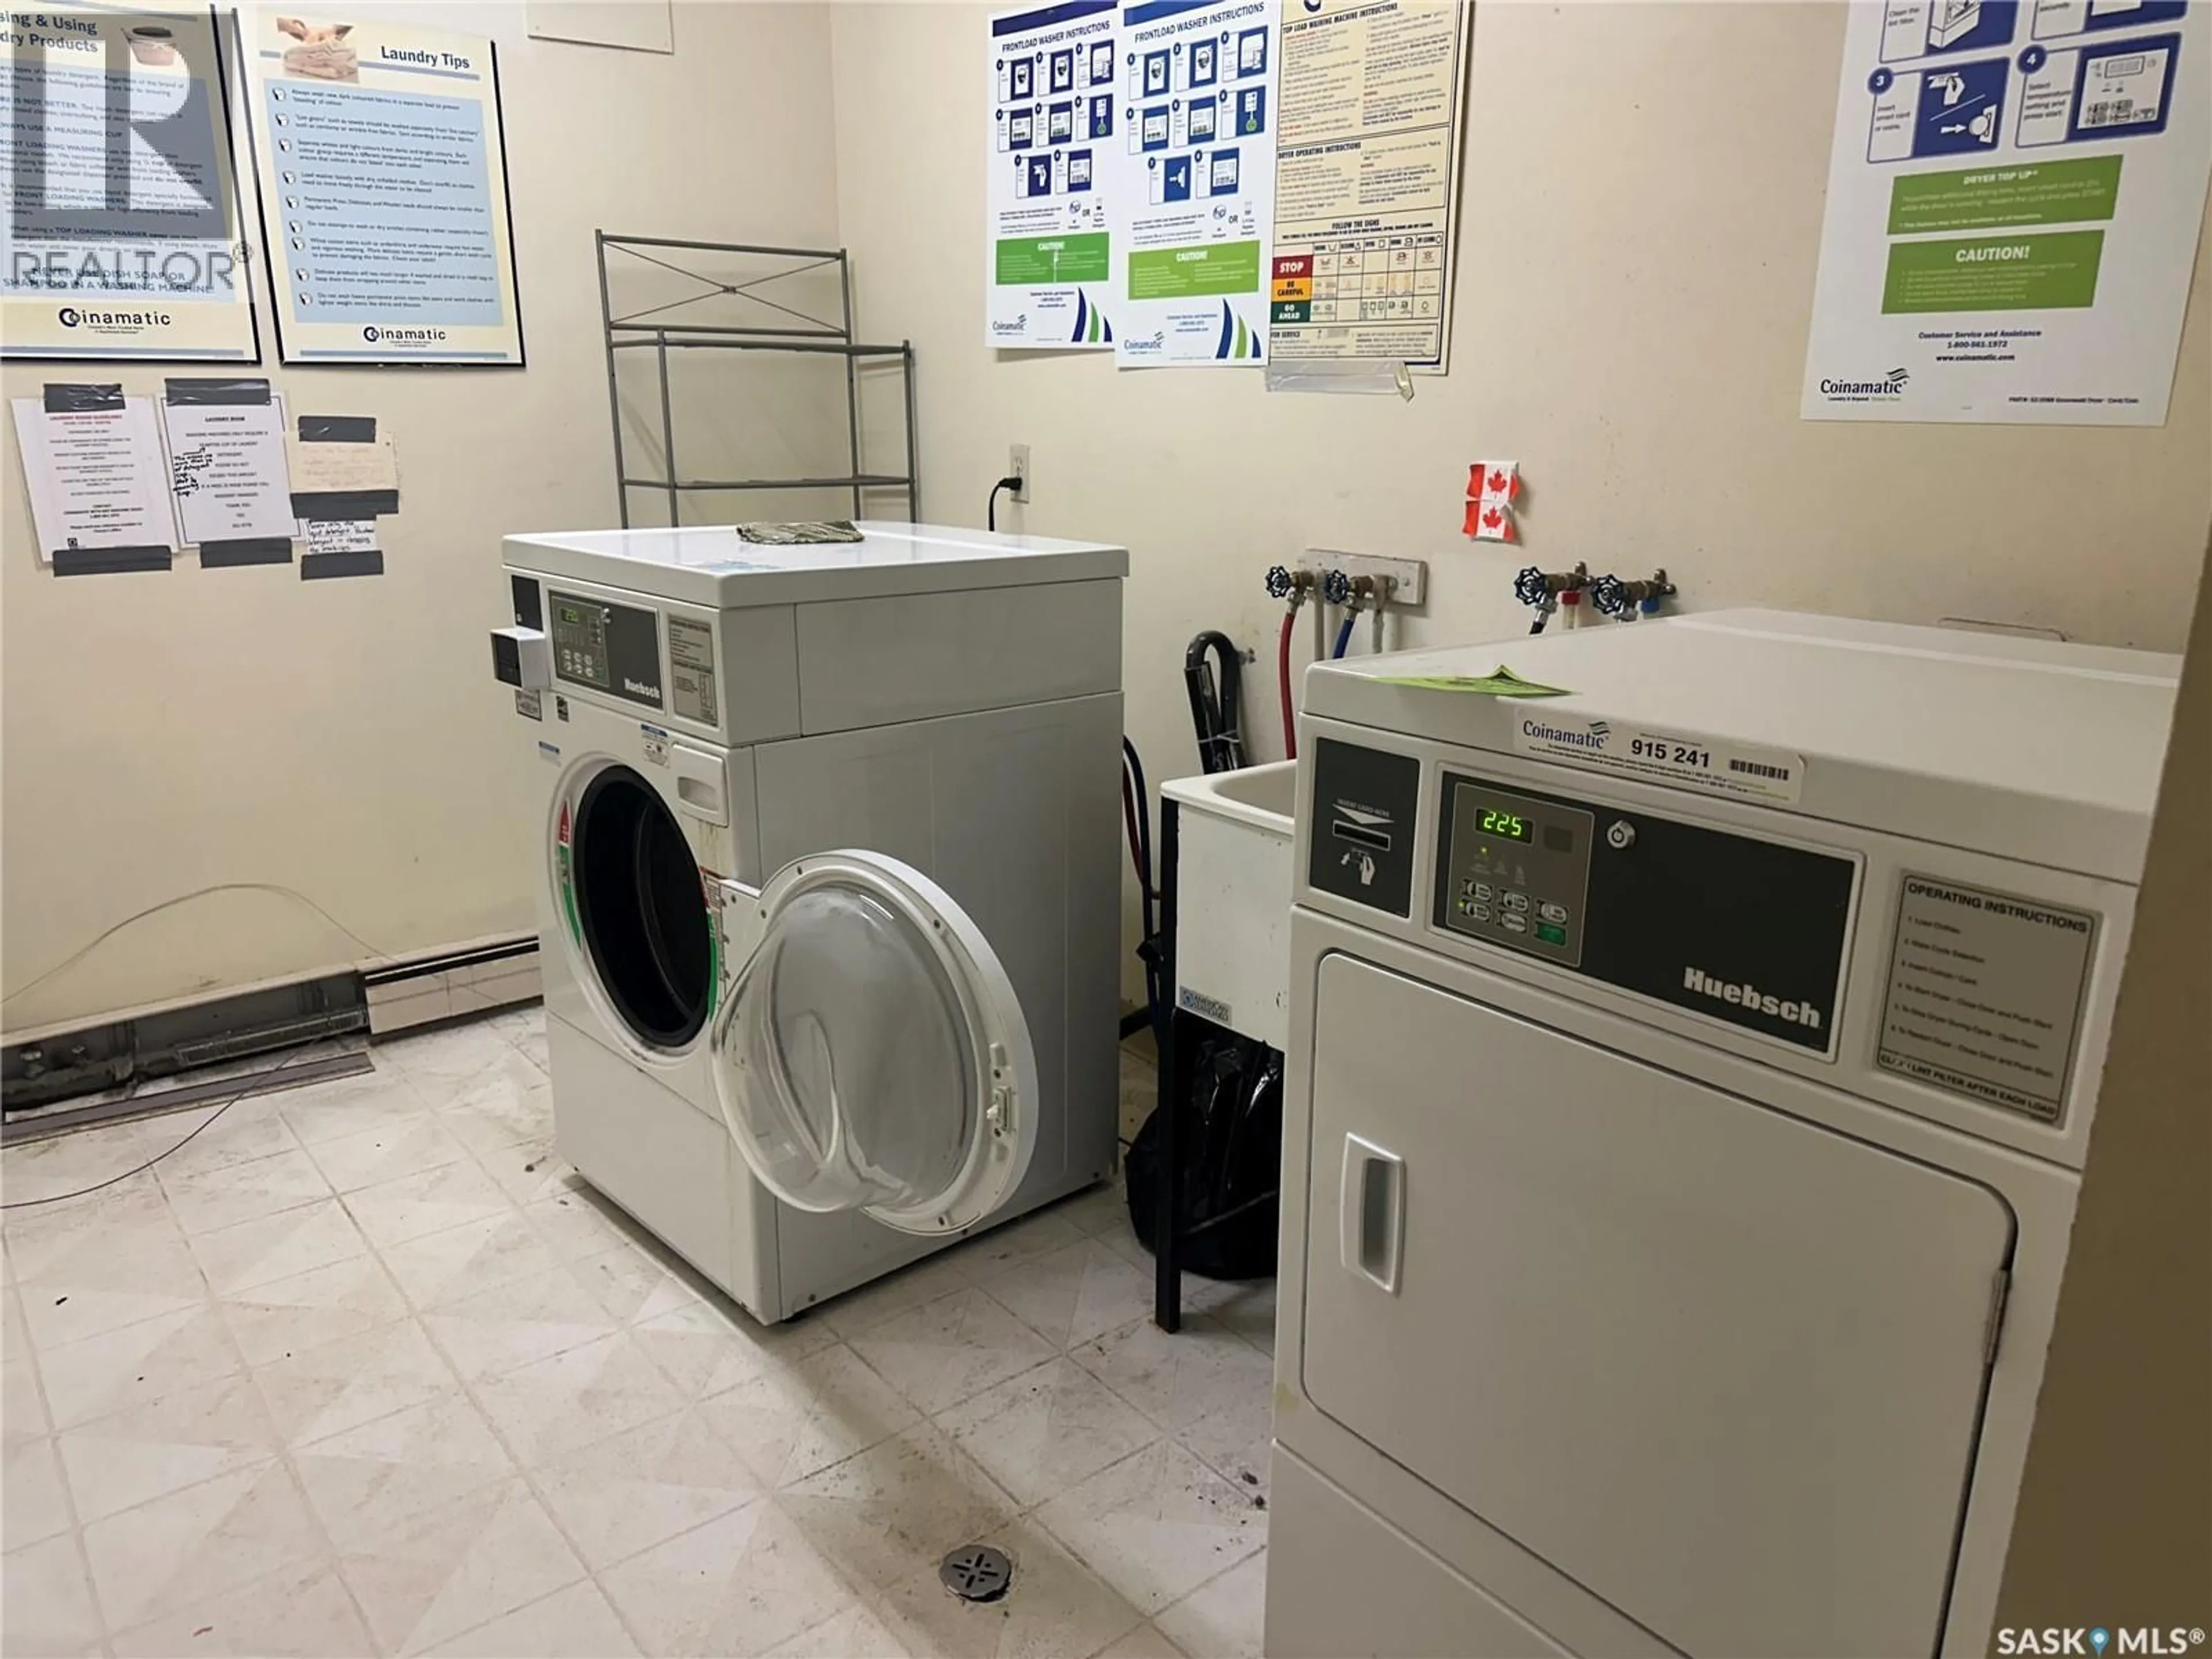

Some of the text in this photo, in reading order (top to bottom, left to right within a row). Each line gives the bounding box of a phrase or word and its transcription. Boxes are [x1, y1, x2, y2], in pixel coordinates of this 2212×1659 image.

[35, 14, 48, 26] &
[52, 16, 97, 35] Using
[1039, 31, 1064, 45] WASHER
[1066, 21, 1110, 39] INSTRUCTIONS
[1135, 2, 1264, 43] FRONTLOAD WASHER INSTRUCTIONS
[29, 33, 98, 52] Products
[381, 46, 470, 70] Laundry Tips
[1964, 173, 1996, 185] DRYER
[1956, 245, 2030, 263] CAUTION!
[1280, 262, 1304, 274] STOP
[59, 308, 172, 327] Coinamatic
[363, 326, 446, 342] Coinamatic
[1523, 719, 1605, 749] Coinamatic
[1631, 738, 1710, 769] 915 241
[1483, 810, 1522, 836] 225
[1907, 882, 2088, 934] OPERATING INSTRUCTIONS
[1683, 966, 1821, 1029] Huebsch
[1933, 1070, 1965, 1088] FILTER
[1965, 1080, 1997, 1097] AFTER
[1999, 1090, 2027, 1106] EACH
